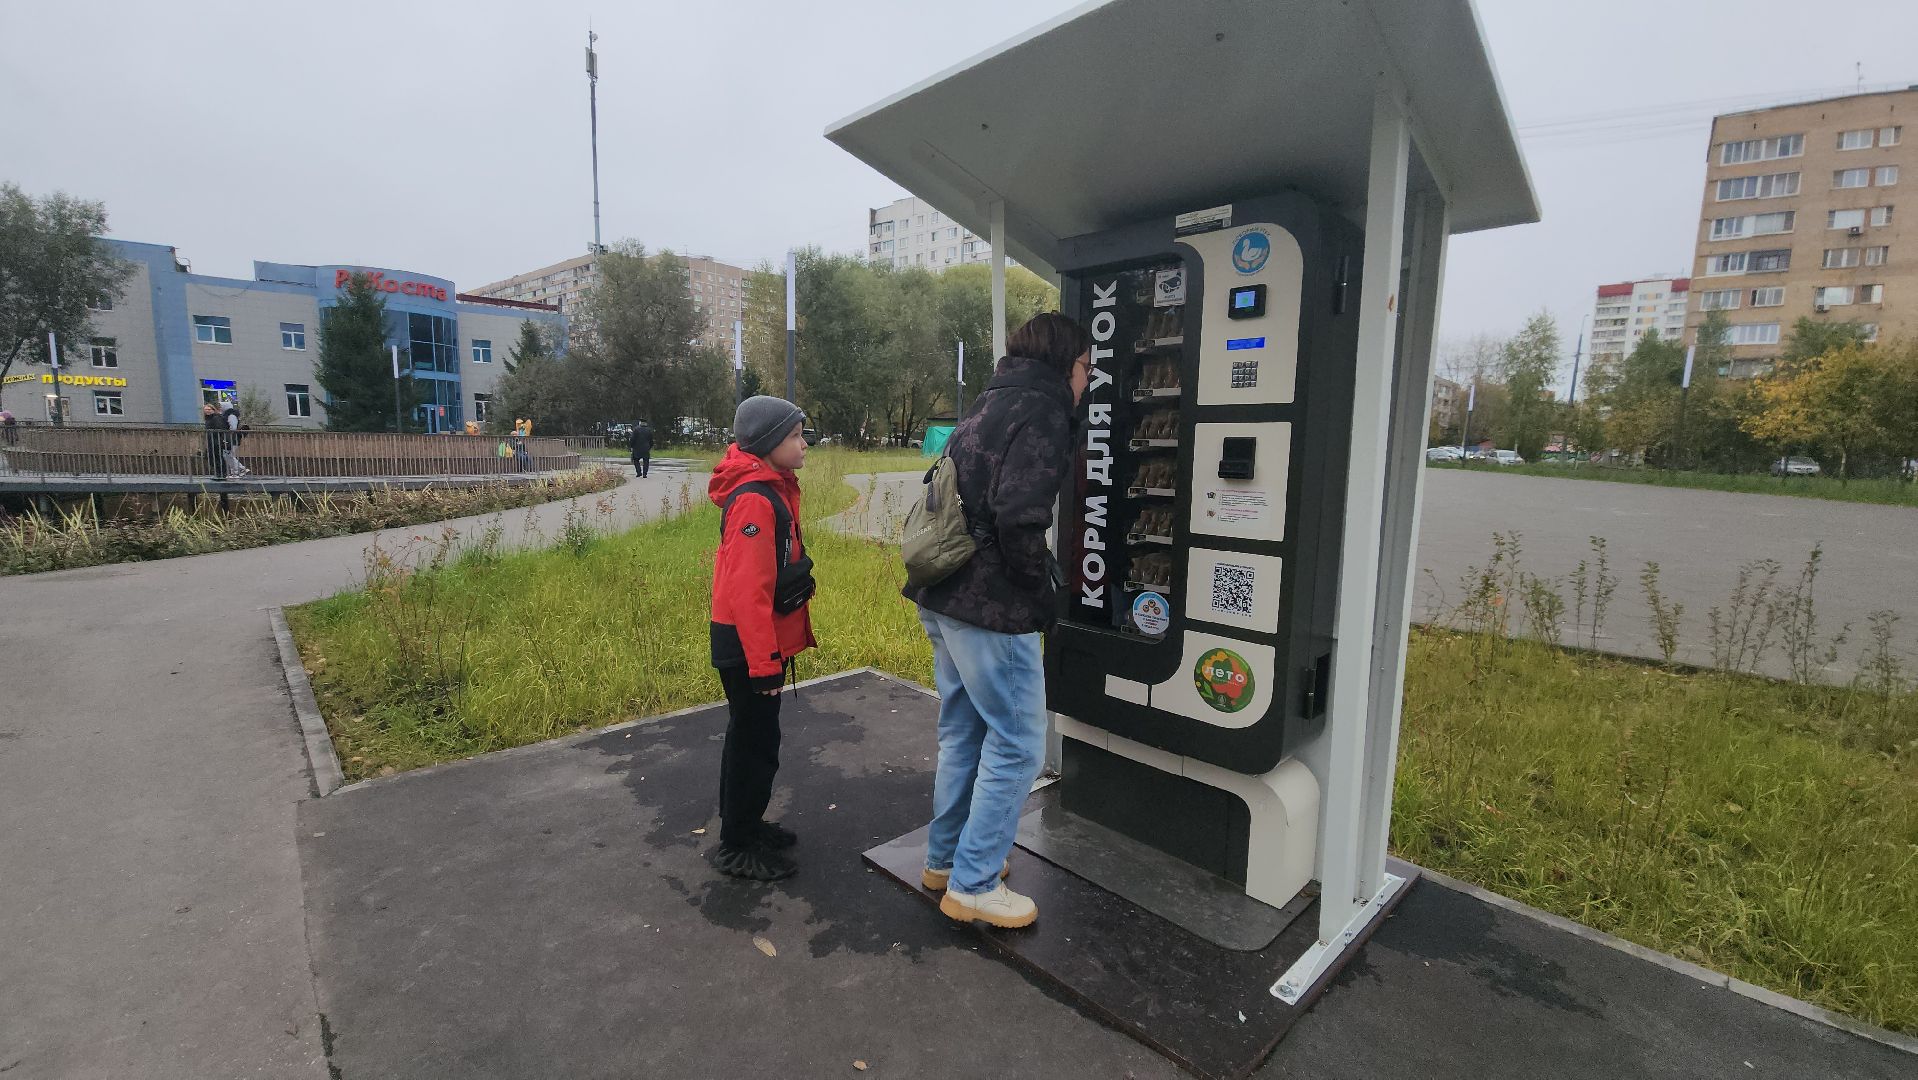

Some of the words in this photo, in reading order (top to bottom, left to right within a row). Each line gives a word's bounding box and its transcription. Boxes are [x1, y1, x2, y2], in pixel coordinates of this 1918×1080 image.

[1089, 279, 1118, 392] УТОК
[1086, 403, 1114, 486] ДЛЯ
[1081, 496, 1108, 609] КОРМ
